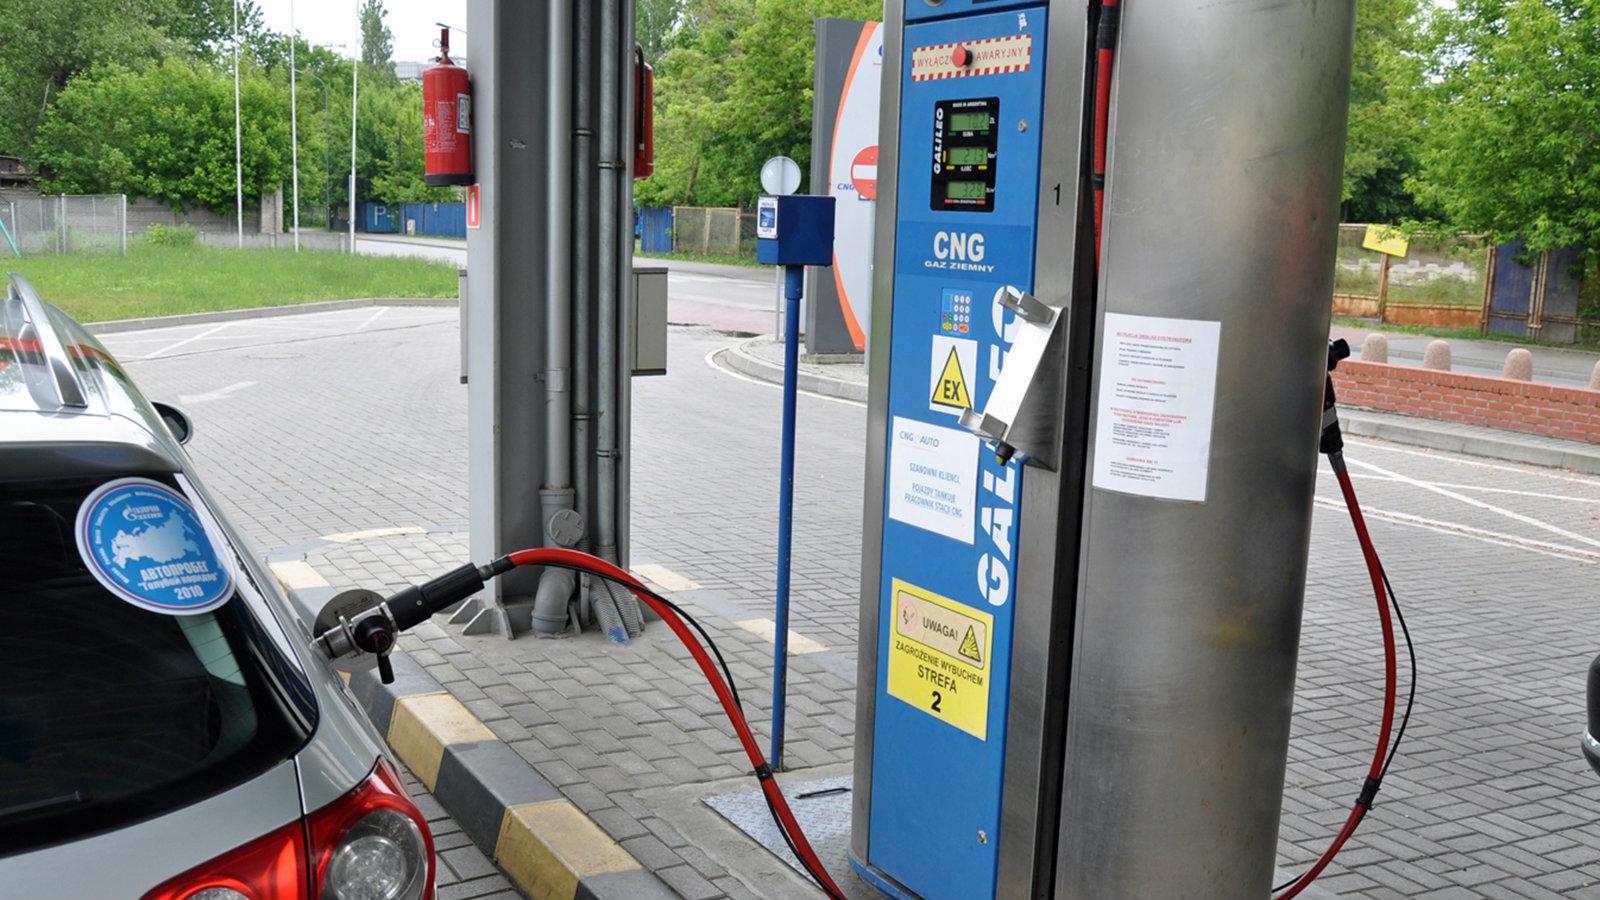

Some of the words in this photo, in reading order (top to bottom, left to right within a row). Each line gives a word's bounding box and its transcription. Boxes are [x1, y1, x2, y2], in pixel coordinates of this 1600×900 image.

[918, 55, 953, 68] WYŁĄCZN
[976, 48, 1024, 60] AWARYJNY
[933, 108, 944, 174] GALILEO
[1054, 183, 1061, 206] 1
[933, 231, 985, 262] CNG
[924, 260, 947, 269] GAZ
[950, 263, 995, 273] ZIEMNY
[943, 379, 961, 402] EX
[899, 430, 914, 442] CNG
[919, 435, 940, 448] AUTO
[909, 462, 937, 478] SZANOWNI
[904, 492, 934, 510] PRACOWNIK
[912, 482, 934, 497] POJAZDY
[934, 488, 956, 504] TANKUJE
[140, 561, 209, 581] АВТОПРОБЕГ
[173, 585, 204, 601] 2010
[922, 617, 959, 641] UWAGA!
[895, 640, 940, 668] ZAGROŻENIE
[940, 660, 984, 687] WYBUCHEM
[917, 664, 958, 694] STREFA
[931, 690, 942, 713] 2
